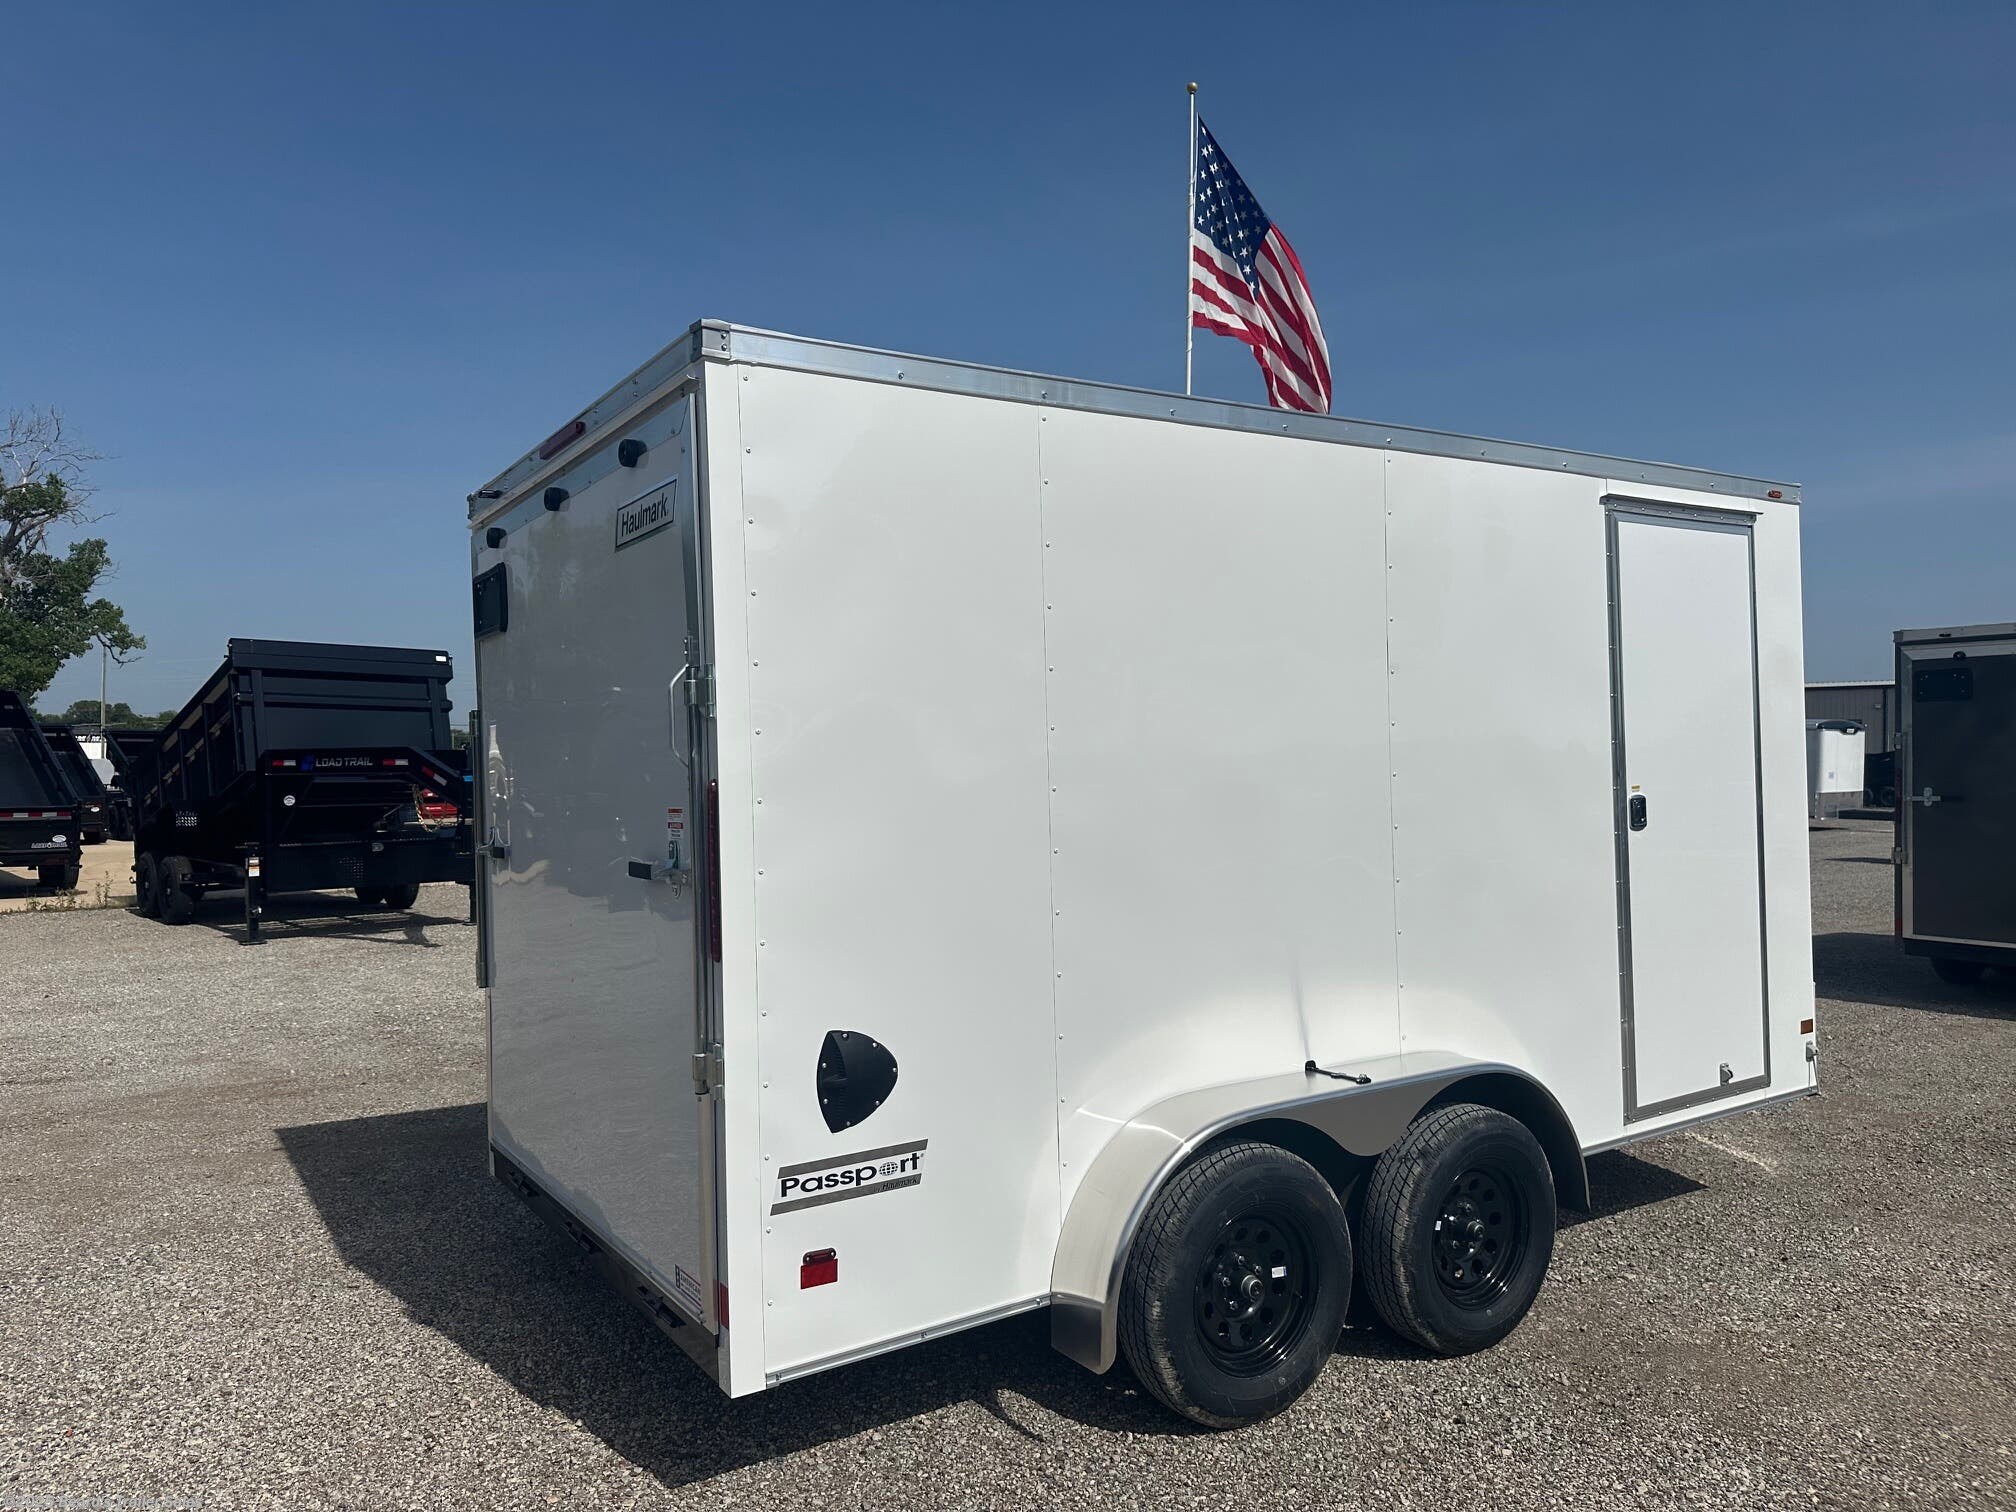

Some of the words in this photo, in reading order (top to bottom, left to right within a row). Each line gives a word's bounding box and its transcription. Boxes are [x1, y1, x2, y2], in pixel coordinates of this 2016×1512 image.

[620, 492, 668, 537] Haulmark
[315, 757, 343, 767] LOAD
[343, 756, 373, 767] TRAIL
